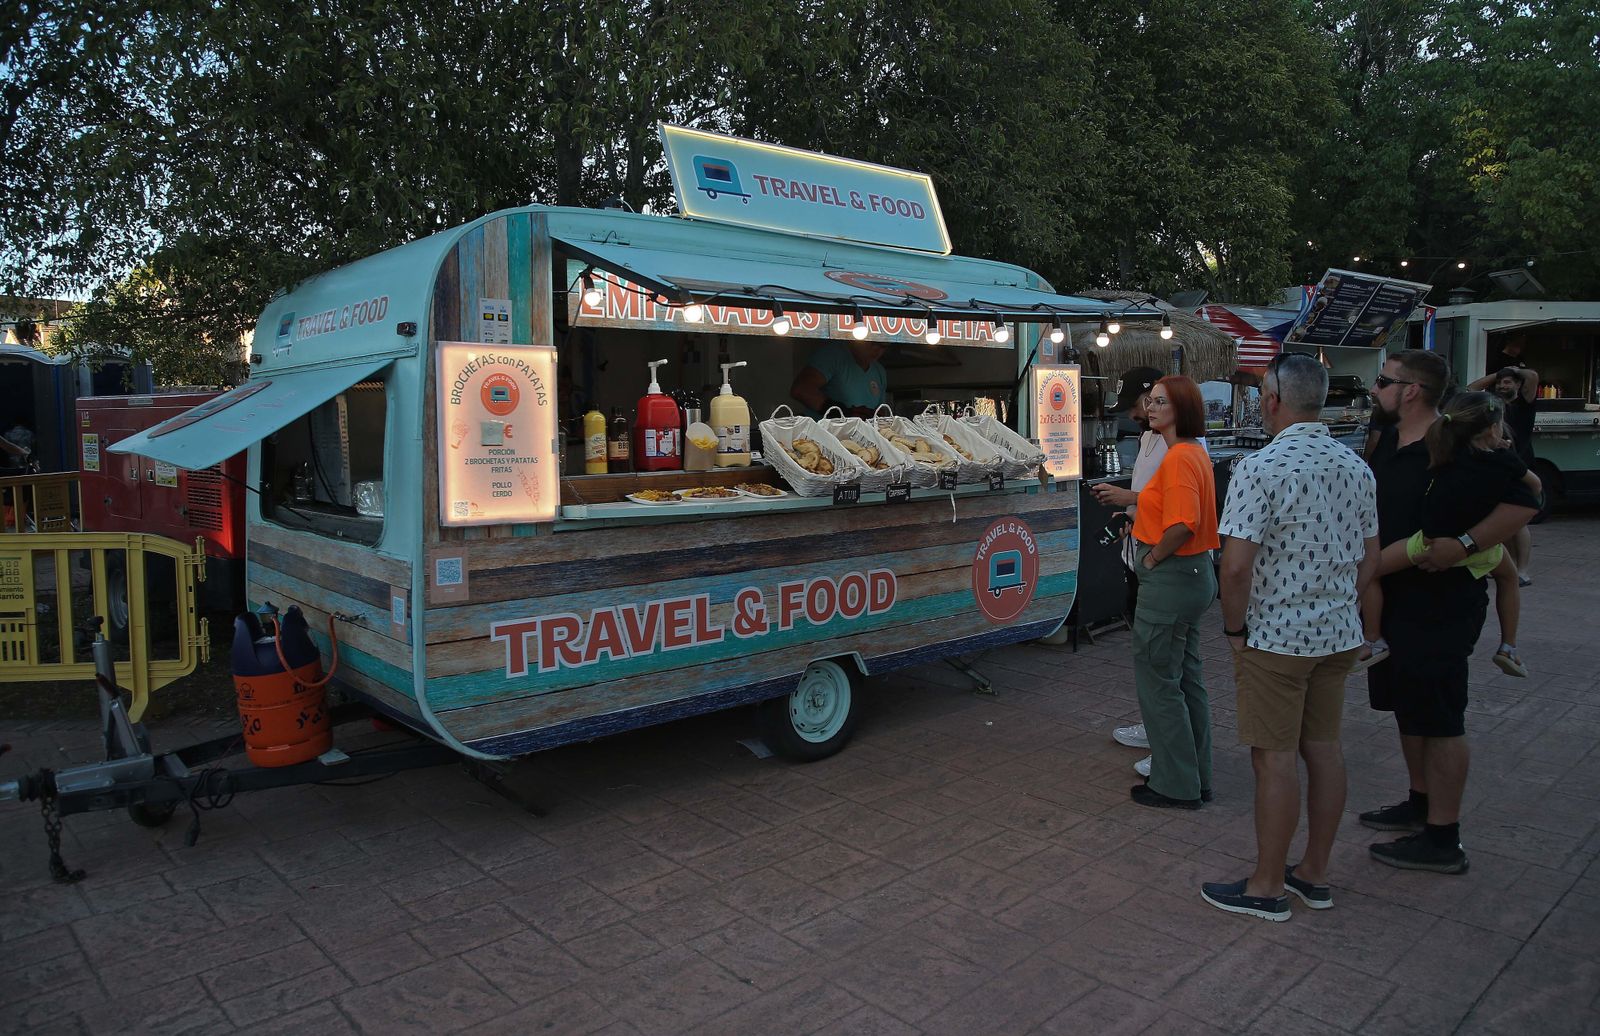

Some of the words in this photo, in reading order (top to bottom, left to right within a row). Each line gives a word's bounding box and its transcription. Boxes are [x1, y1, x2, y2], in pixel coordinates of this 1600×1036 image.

[753, 174, 846, 208] TRAVEL
[849, 191, 866, 210] &
[868, 193, 926, 220] FOOD
[296, 308, 337, 341] TRAVEL
[339, 305, 350, 330] &
[350, 295, 390, 327] FOOD
[579, 270, 820, 332] EMPNADAS
[450, 353, 496, 405] BROCHETAS
[497, 355, 515, 367] con
[515, 360, 547, 406] PATATAS
[503, 424, 513, 438] €
[977, 524, 1007, 561] TRAVEL
[1008, 522, 1015, 533] &
[1016, 525, 1035, 555] FOOD
[490, 592, 725, 679] TRAVEL
[732, 586, 770, 639] &
[775, 568, 898, 632] FOOD
